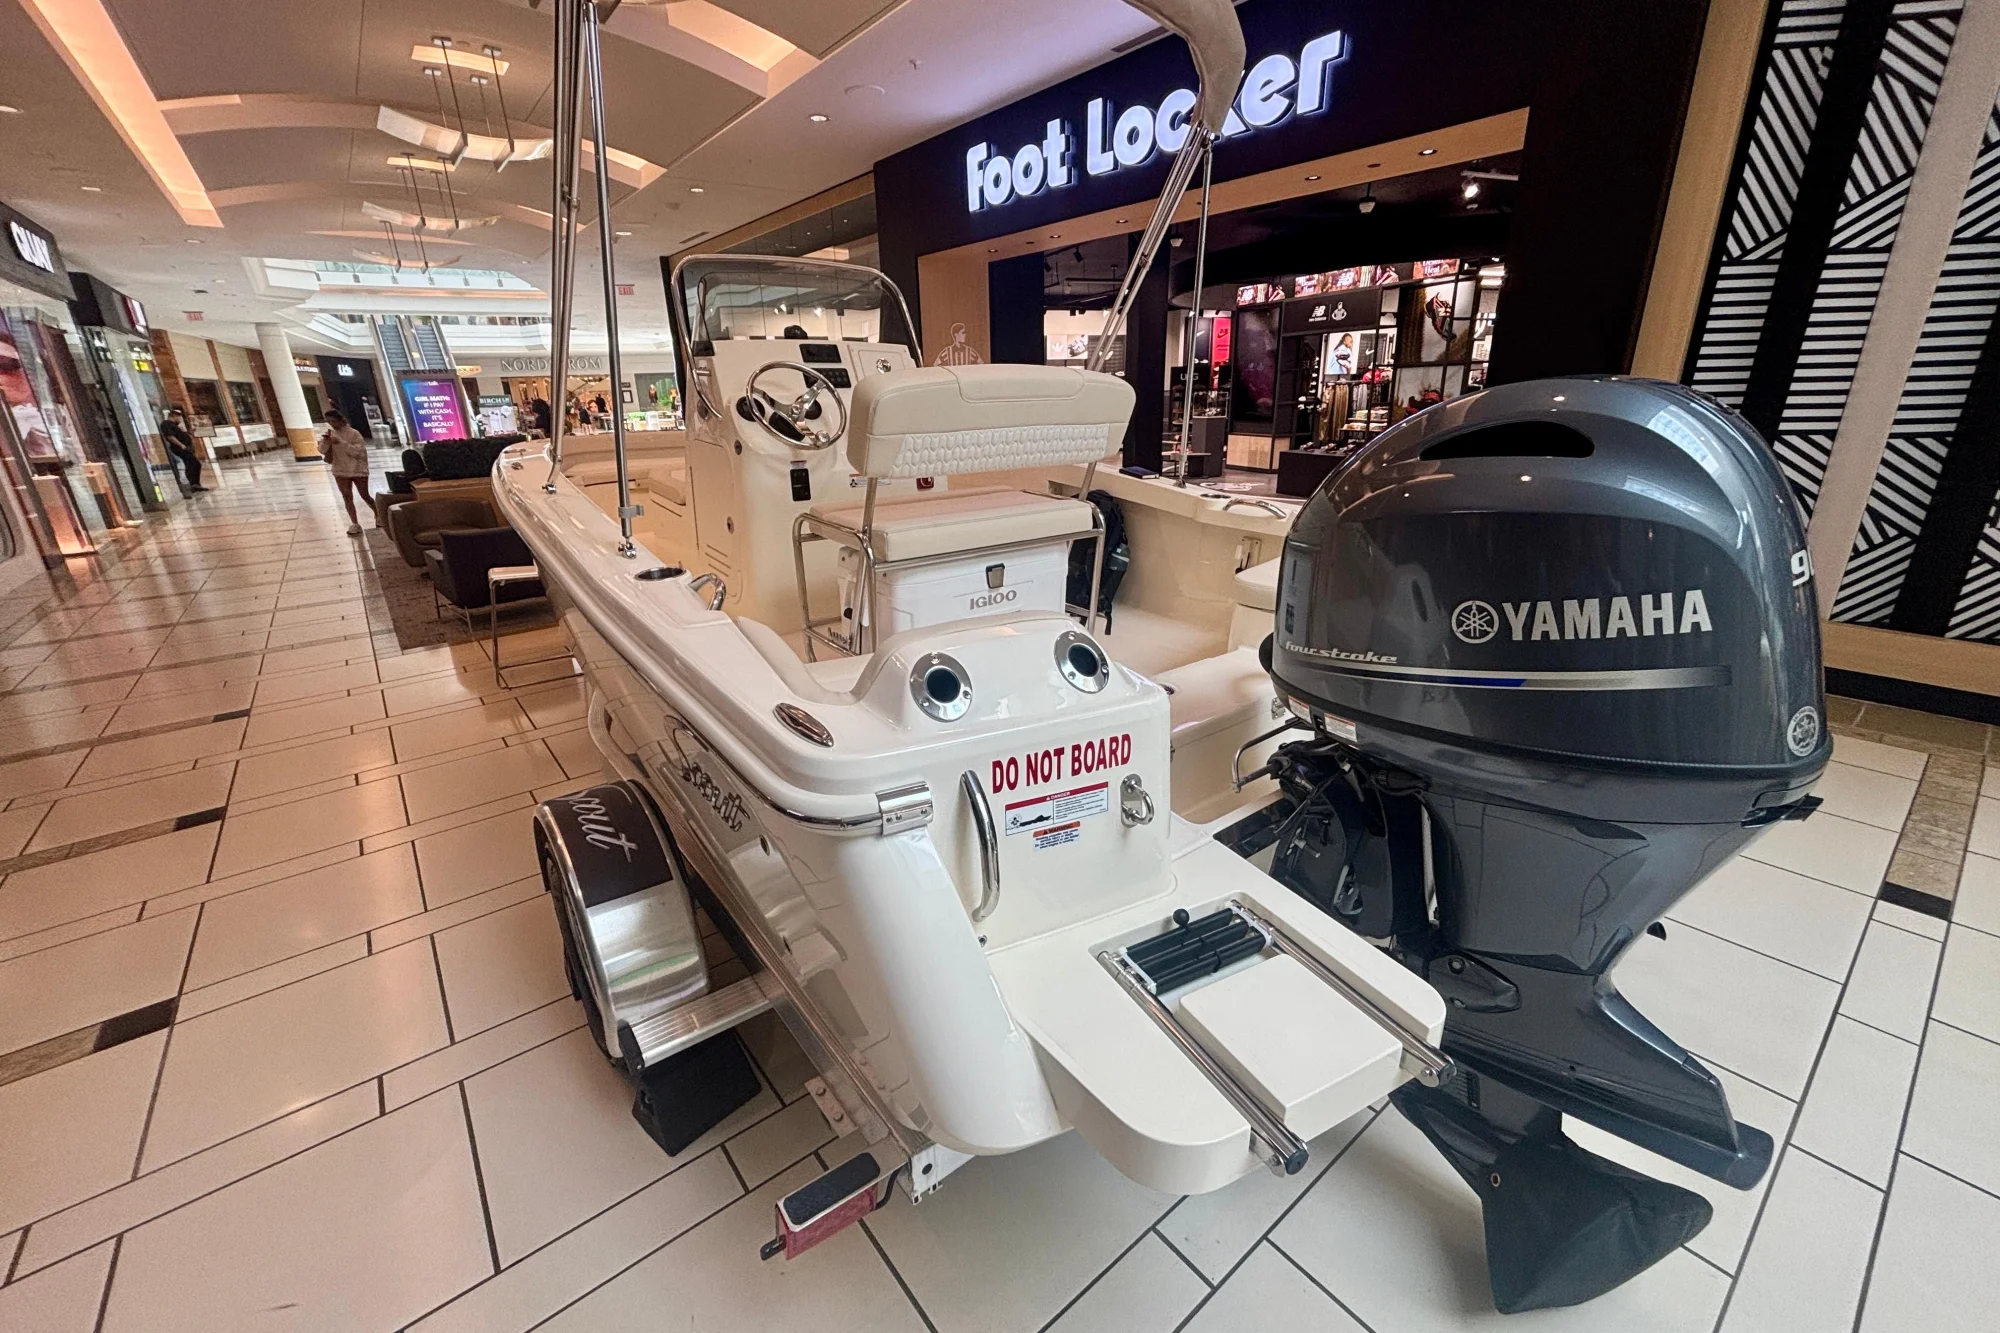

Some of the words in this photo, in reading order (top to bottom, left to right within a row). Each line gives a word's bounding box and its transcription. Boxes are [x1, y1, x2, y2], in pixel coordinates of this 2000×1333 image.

[966, 118, 1071, 212] Foot
[1087, 30, 1348, 176] Locer
[501, 357, 602, 372] NORDROM
[1180, 372, 1199, 381] UG
[1791, 546, 1814, 587] 9
[969, 590, 1017, 611] IGLOO
[1501, 589, 1712, 642] YAMAHA
[992, 756, 1019, 794] DO
[1026, 746, 1065, 787] NOT
[1071, 733, 1132, 777] BOARD
